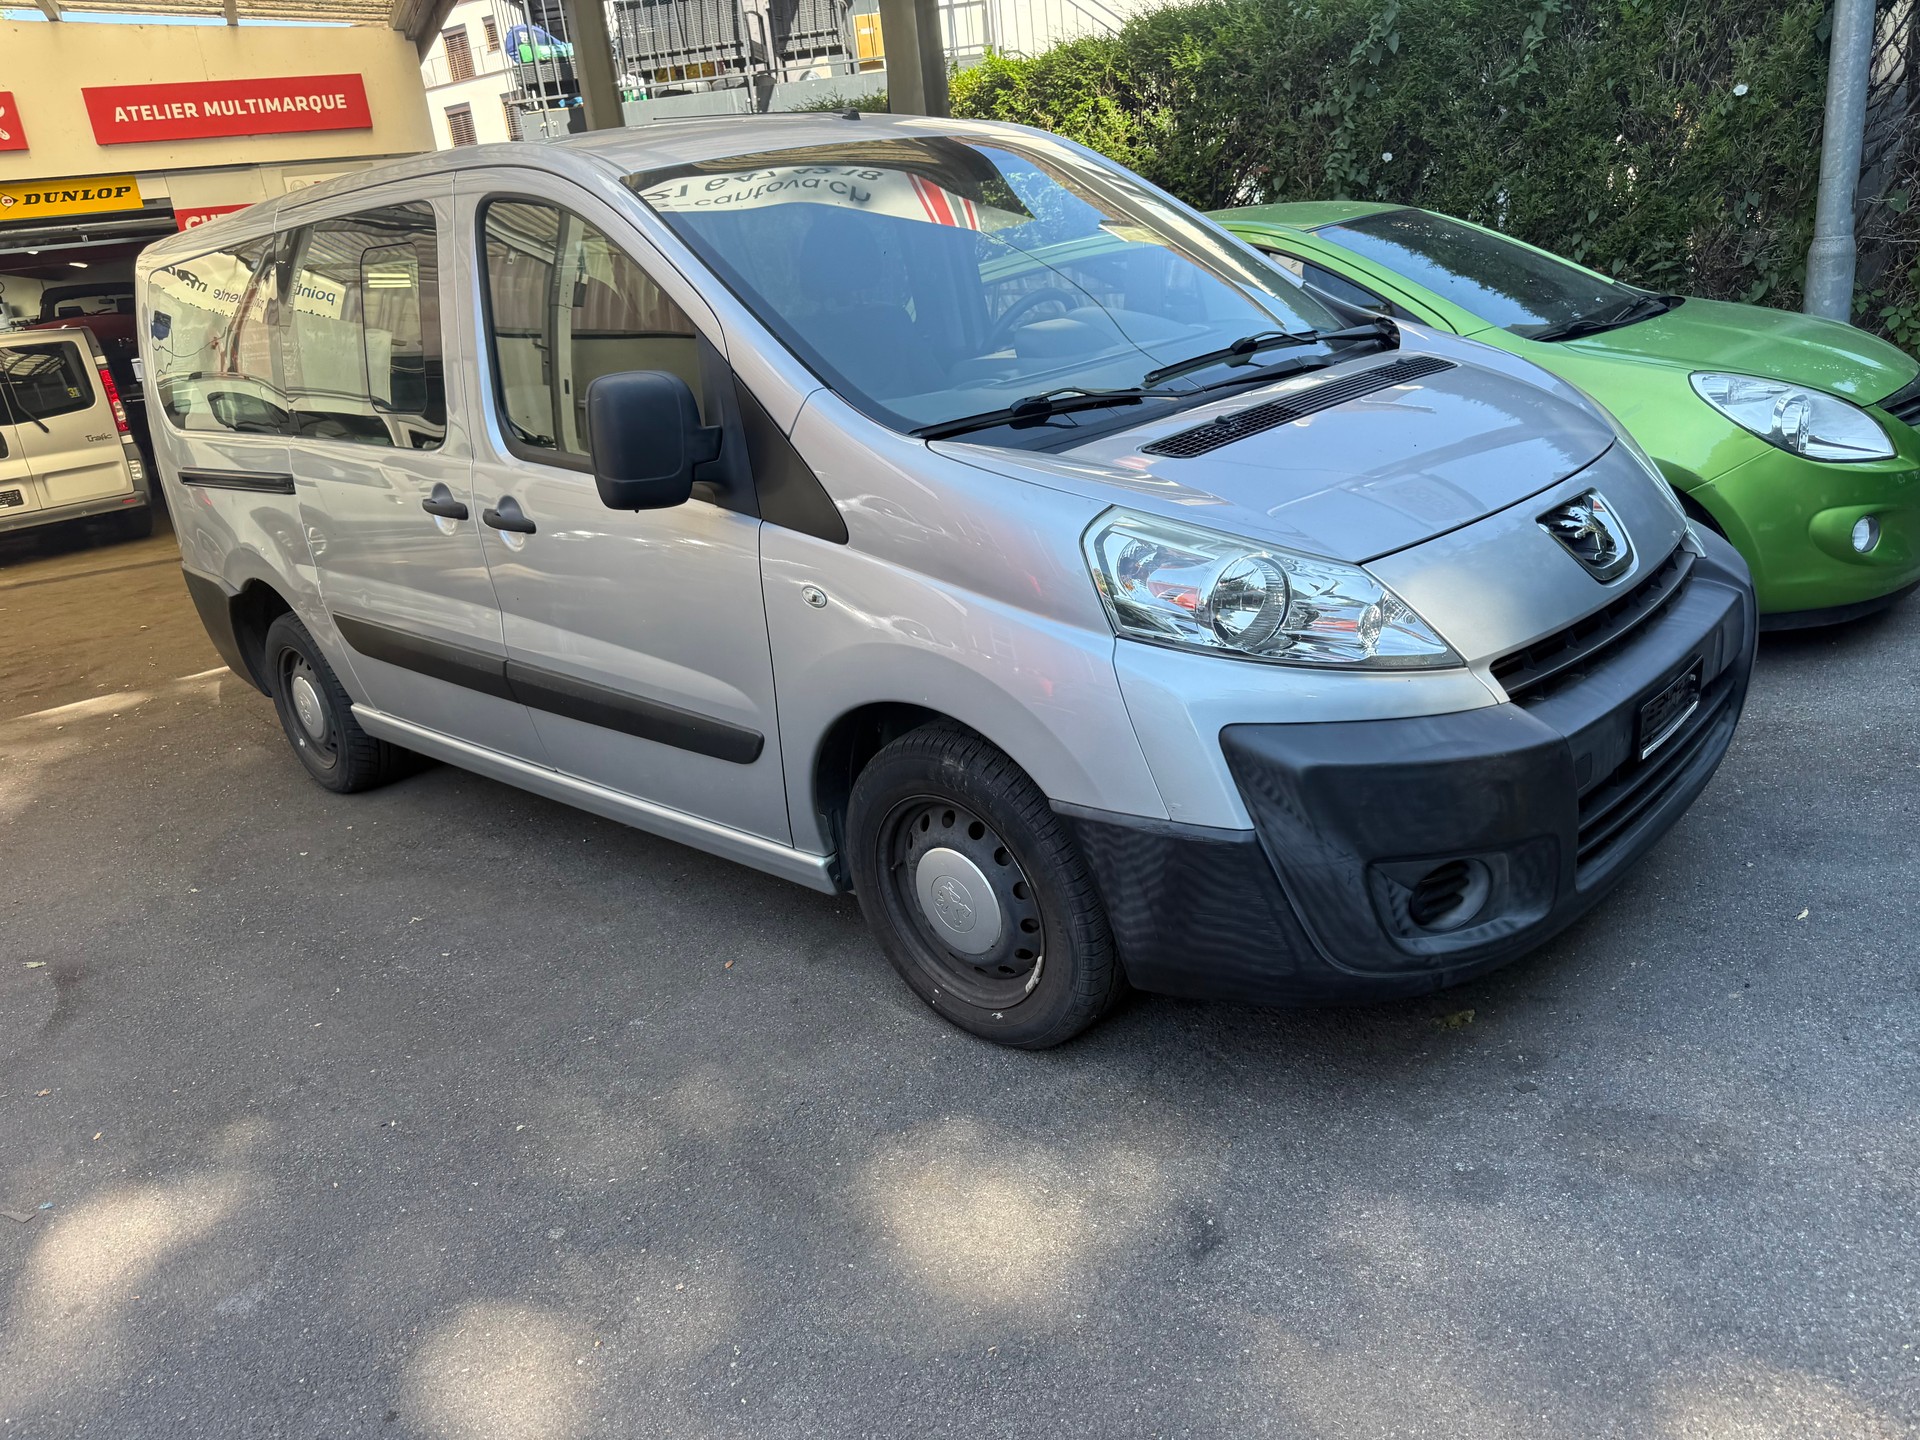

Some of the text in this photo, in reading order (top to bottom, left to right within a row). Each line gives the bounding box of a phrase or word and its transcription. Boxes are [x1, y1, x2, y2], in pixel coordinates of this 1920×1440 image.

[114, 93, 348, 123] ATELIER MULTIMARQUE
[22, 185, 132, 206] DUNLOP
[84, 432, 113, 443] Trafic
